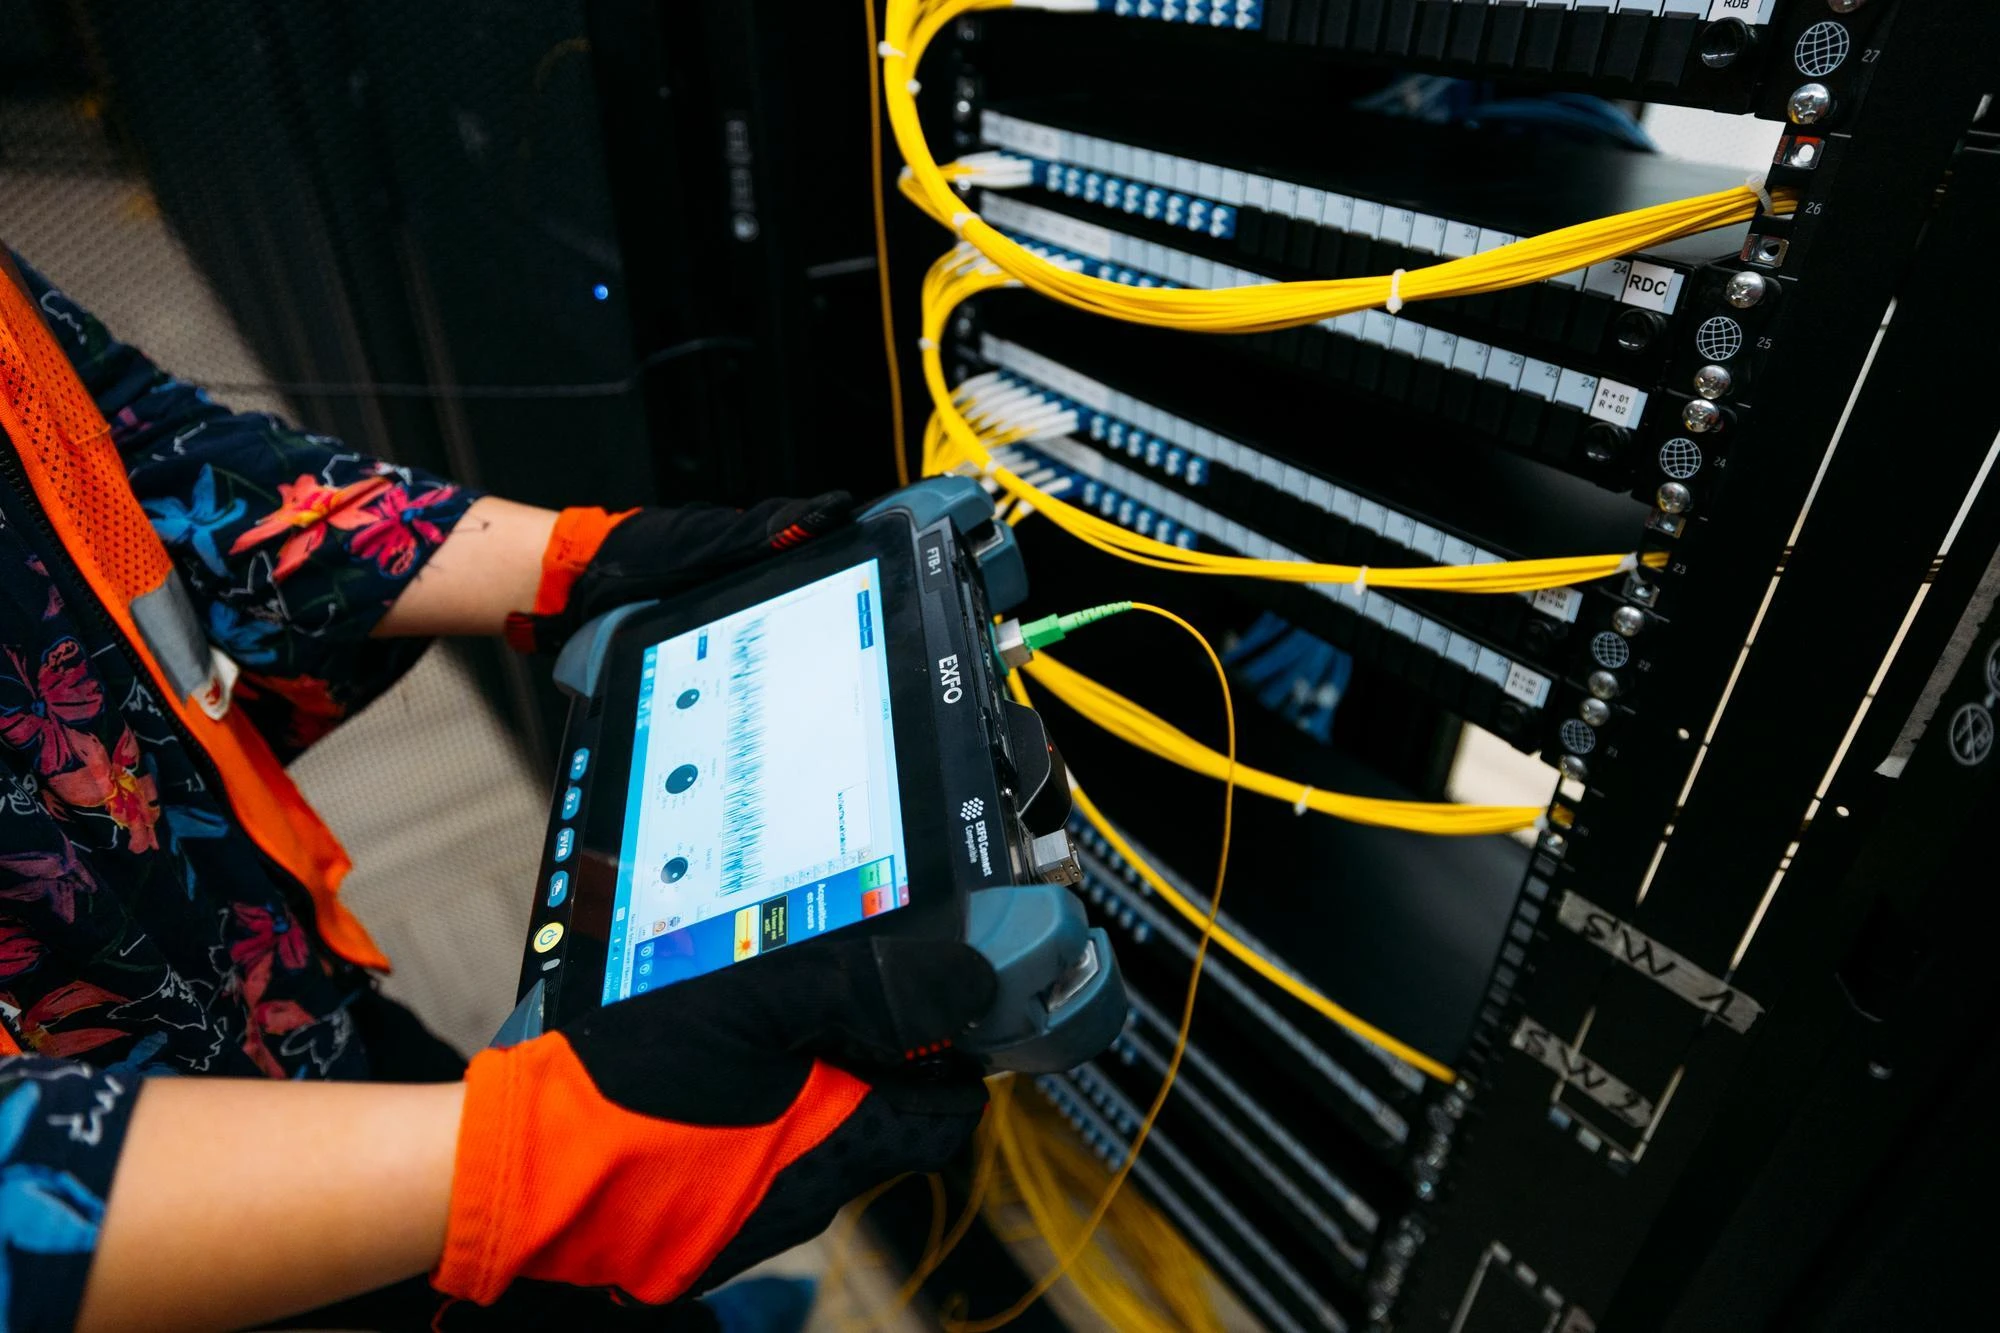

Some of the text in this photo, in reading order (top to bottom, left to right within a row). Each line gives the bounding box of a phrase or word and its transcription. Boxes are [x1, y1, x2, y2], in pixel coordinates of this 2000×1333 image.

[1862, 50, 1880, 63] 27
[1805, 201, 1822, 215] 26
[1434, 218, 1445, 231] 19
[1464, 226, 1478, 240] 20
[1612, 261, 1627, 275] 24
[1628, 274, 1667, 296] RDC
[1442, 334, 1456, 347] 20
[1757, 336, 1773, 350] 25
[1476, 344, 1489, 357] 21
[1509, 354, 1523, 368] 22
[1544, 365, 1558, 379] 23
[1581, 376, 1595, 390] 24
[1602, 388, 1610, 399] R
[1618, 394, 1630, 404] 01
[1599, 400, 1606, 410] R
[1615, 405, 1626, 416] 02
[1713, 456, 1727, 469] 24
[927, 546, 943, 576] FTB-1
[1673, 562, 1687, 574] 23
[938, 654, 963, 704] EXFO
[965, 824, 979, 864] Compatible
[975, 820, 993, 877] EXFO Connect
[807, 891, 815, 930] en cours
[817, 883, 828, 932] Acquisition
[1584, 912, 1736, 1023] SW 1
[1524, 1029, 1608, 1090] SW
